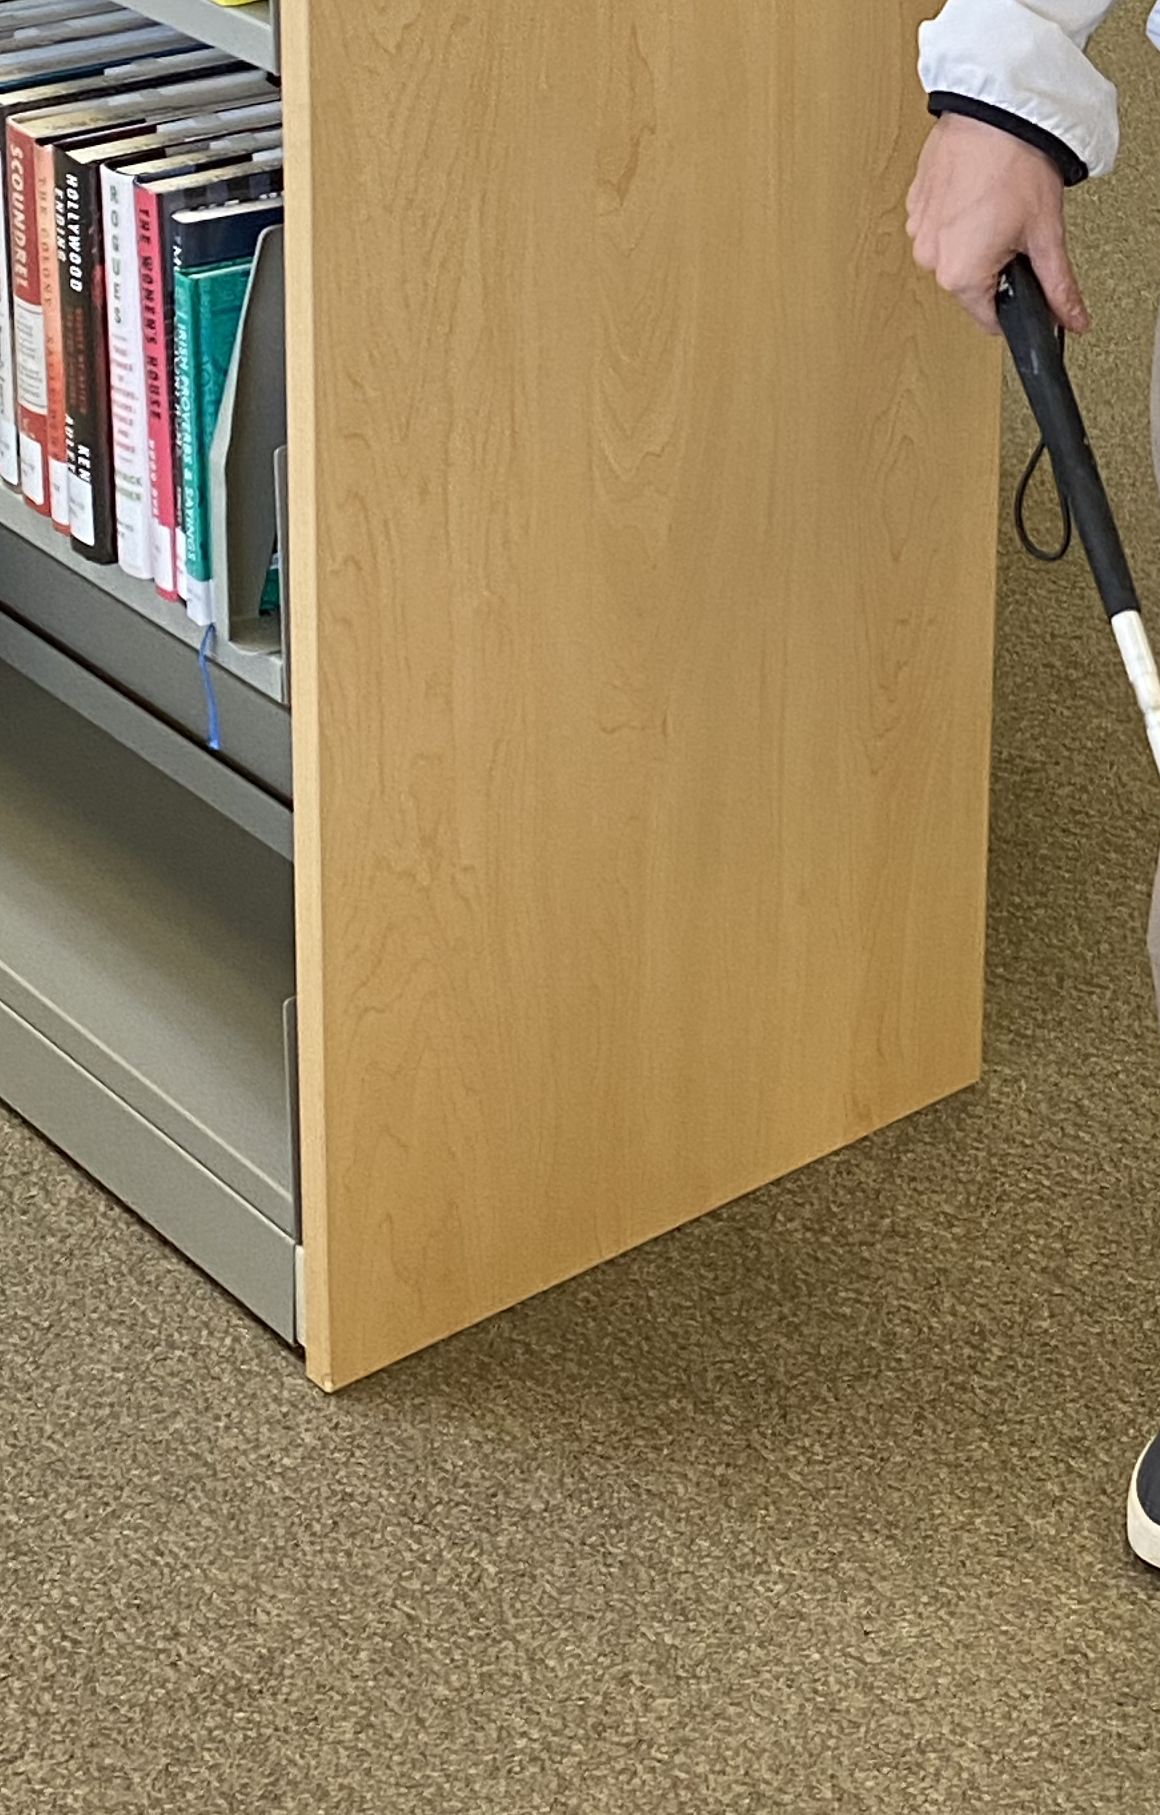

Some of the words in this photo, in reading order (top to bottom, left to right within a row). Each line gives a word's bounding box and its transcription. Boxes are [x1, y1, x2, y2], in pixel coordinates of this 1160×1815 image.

[10, 143, 29, 290] SCOUNDREL
[54, 187, 67, 262] ENDING
[65, 173, 83, 293] HOLLYWOOD
[109, 185, 122, 324] ROGUES
[139, 208, 151, 245] THE
[141, 256, 158, 345] WOMEN'S
[177, 323, 189, 371] IRISH
[147, 354, 162, 421] HOUSE
[180, 375, 193, 465] PROVERBS
[77, 443, 92, 484] KEN
[184, 486, 197, 562] SAYINGS
